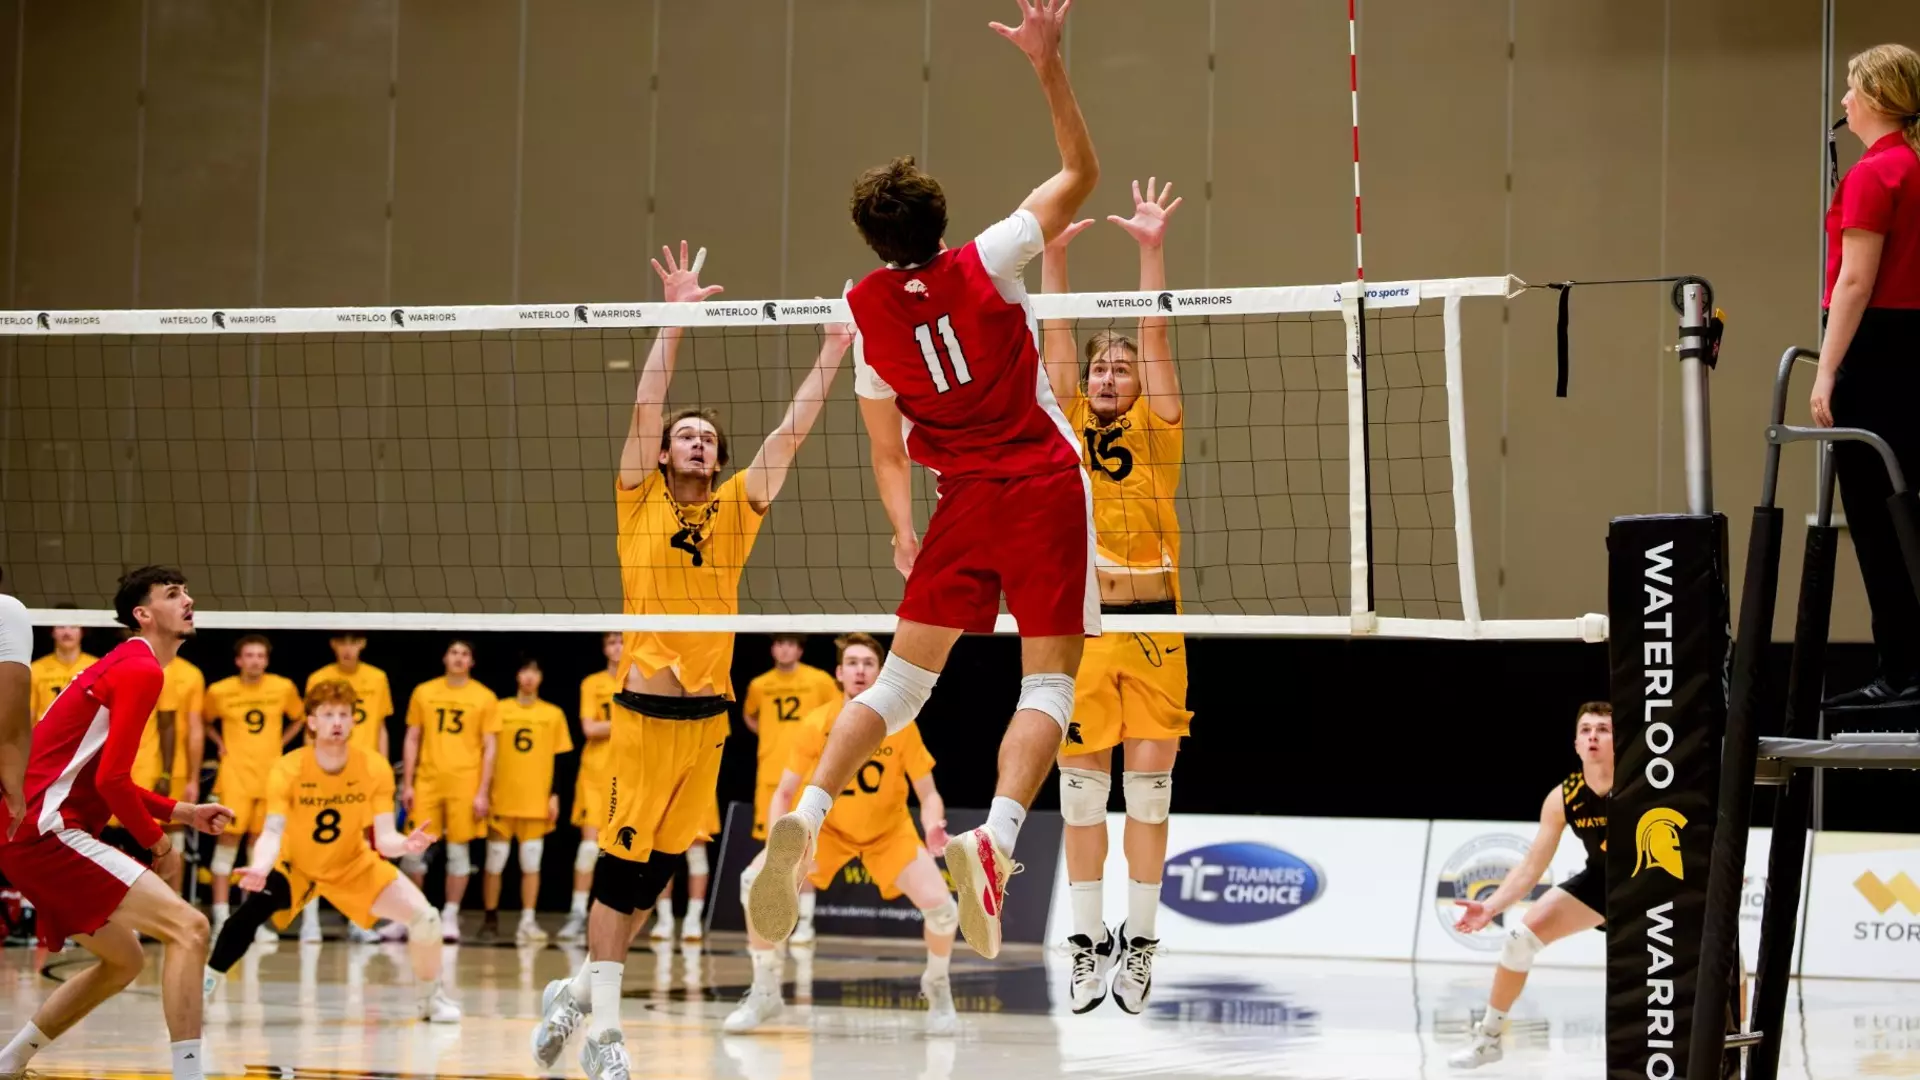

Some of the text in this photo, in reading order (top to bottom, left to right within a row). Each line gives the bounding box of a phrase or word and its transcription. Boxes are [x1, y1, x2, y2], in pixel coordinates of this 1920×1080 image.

[1097, 296, 1232, 308] WATERLOO WARRIORS
[1379, 287, 1409, 299] sports
[54, 316, 101, 325] WARRIORS
[159, 315, 276, 325] WATERLOO WARRIORS
[337, 313, 457, 323] WATERLOO WARRIORS
[519, 309, 642, 320] WATERLOO WARRIORS
[705, 305, 832, 317] WATERLOO WARRIORS
[914, 313, 973, 394] 11
[1083, 427, 1133, 481] 15
[1644, 540, 1675, 789] WATERLOO
[774, 696, 801, 721] 12
[244, 708, 265, 734] 9
[436, 708, 464, 734] 13
[514, 728, 533, 752] 6
[840, 759, 885, 796] 0
[313, 808, 341, 844] 8
[1227, 866, 1306, 886] TRAINERS
[1223, 883, 1303, 905] CHOICE
[1854, 921, 1920, 943] STOR
[1646, 901, 1675, 1080] WARRIO
